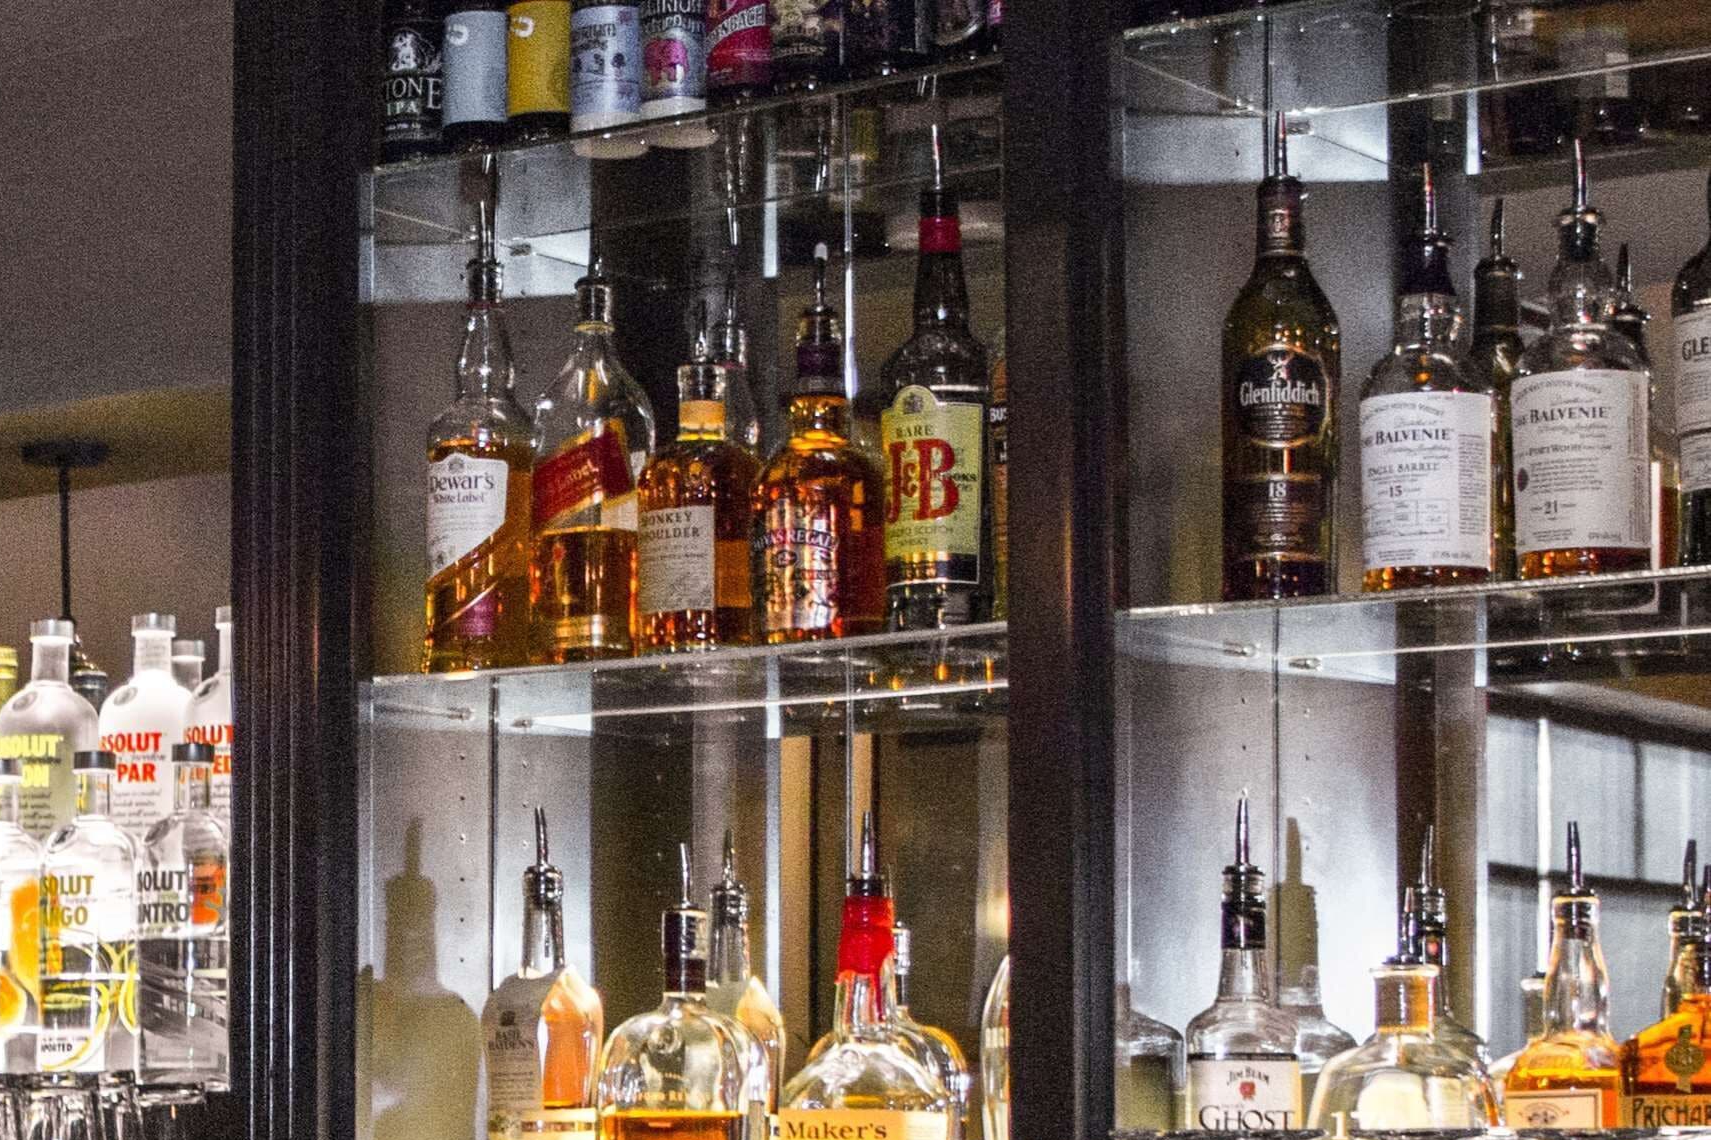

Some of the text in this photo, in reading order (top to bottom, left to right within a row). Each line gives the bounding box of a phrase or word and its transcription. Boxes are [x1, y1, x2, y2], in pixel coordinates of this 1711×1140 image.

[1240, 381, 1320, 406] Glenfiddich
[1529, 405, 1611, 424] BALVENIE
[895, 424, 934, 438] RARE
[1375, 428, 1452, 446] BALVENIE
[429, 472, 495, 494] Dewar's
[886, 438, 960, 525] J&B
[1268, 482, 1287, 498] 18
[1389, 485, 1403, 498] 15
[1544, 500, 1558, 514] 21
[1245, 1066, 1270, 1084] BEAM
[1199, 1104, 1295, 1131] GHOST
[786, 1121, 887, 1140] Maker's
